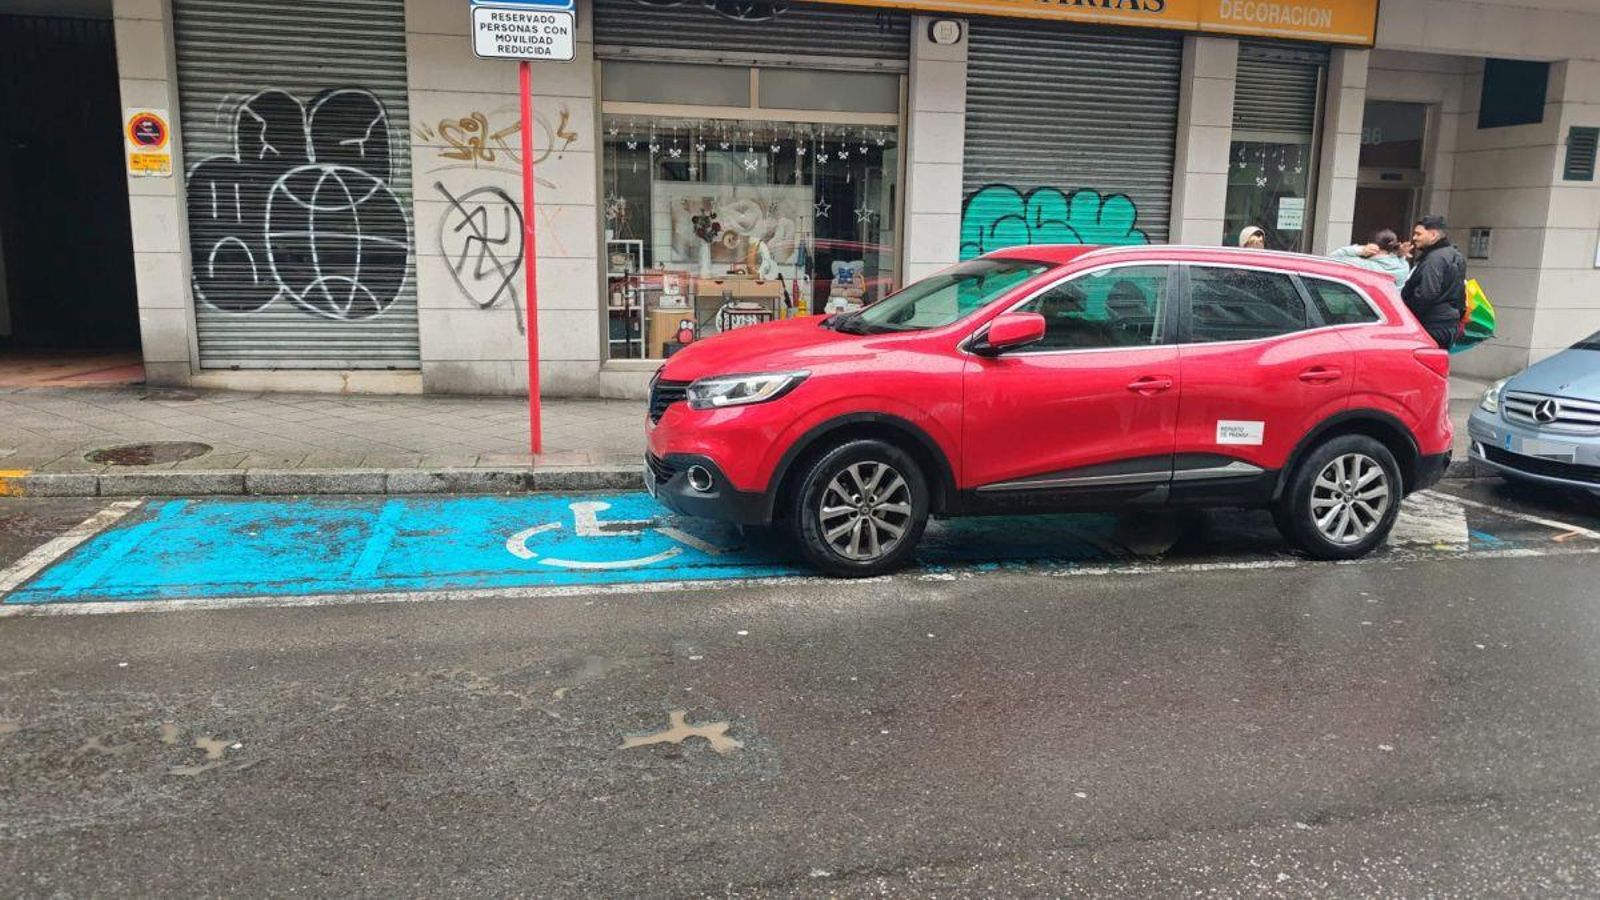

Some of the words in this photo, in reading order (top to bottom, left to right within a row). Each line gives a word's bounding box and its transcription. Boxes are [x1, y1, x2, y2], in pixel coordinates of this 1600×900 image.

[491, 12, 556, 24] RESERVADO
[1219, 0, 1333, 28] DECORACION
[480, 22, 538, 34] PERSONAS
[543, 26, 568, 35] CON
[495, 34, 553, 45] MOVILIDAD
[497, 44, 552, 55] REDUCIDA
